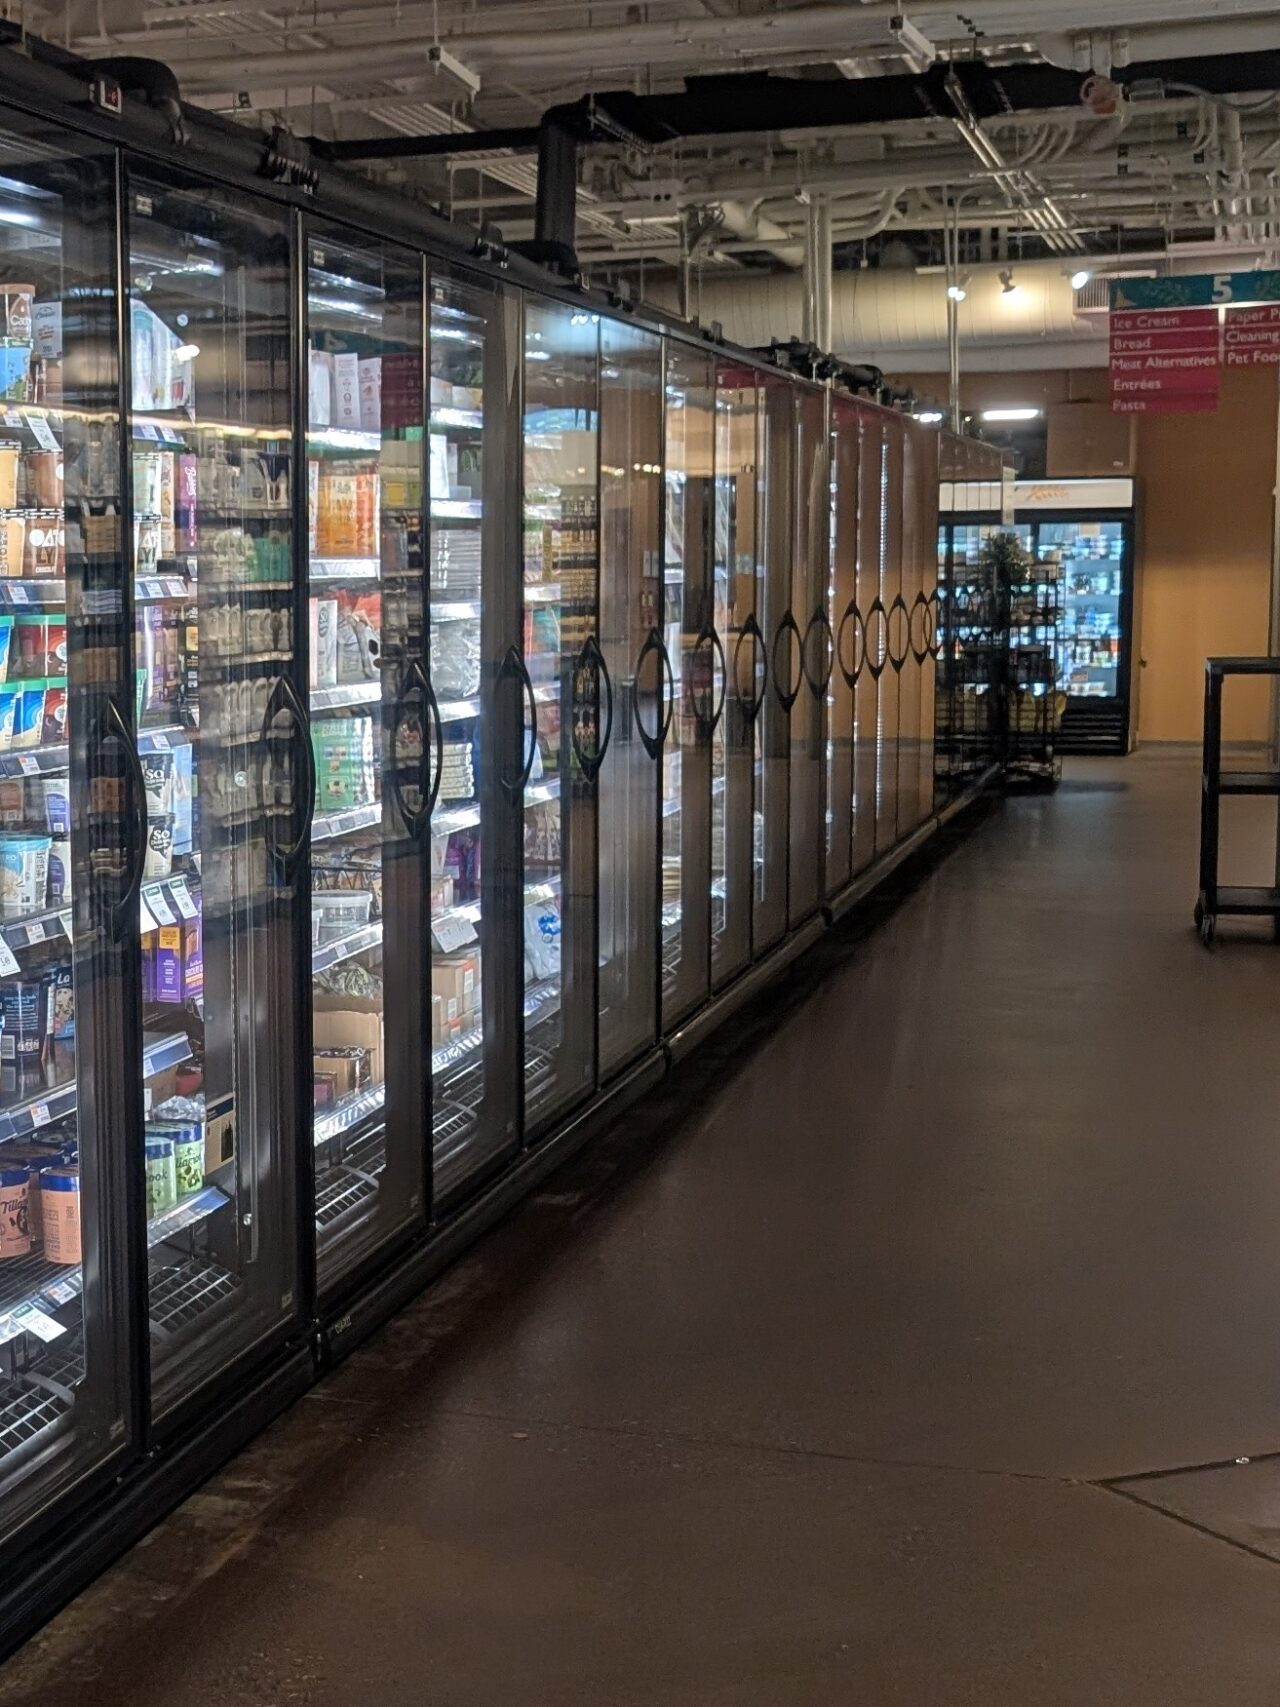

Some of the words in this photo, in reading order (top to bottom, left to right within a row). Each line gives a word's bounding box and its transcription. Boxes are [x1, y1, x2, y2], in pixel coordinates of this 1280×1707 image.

[1212, 276, 1232, 302] 5
[1114, 318, 1132, 329] Ice
[1137, 316, 1180, 328] Cream
[1228, 308, 1265, 326] Paper
[1114, 337, 1151, 349] Bread
[1226, 331, 1279, 343] Cleaning
[1111, 358, 1143, 370] Meat
[1145, 355, 1217, 369] Alternatives
[1228, 352, 1249, 365] Pet
[1253, 350, 1280, 362] Foo
[1114, 378, 1161, 390] Entrées
[1113, 399, 1146, 411] Pasta
